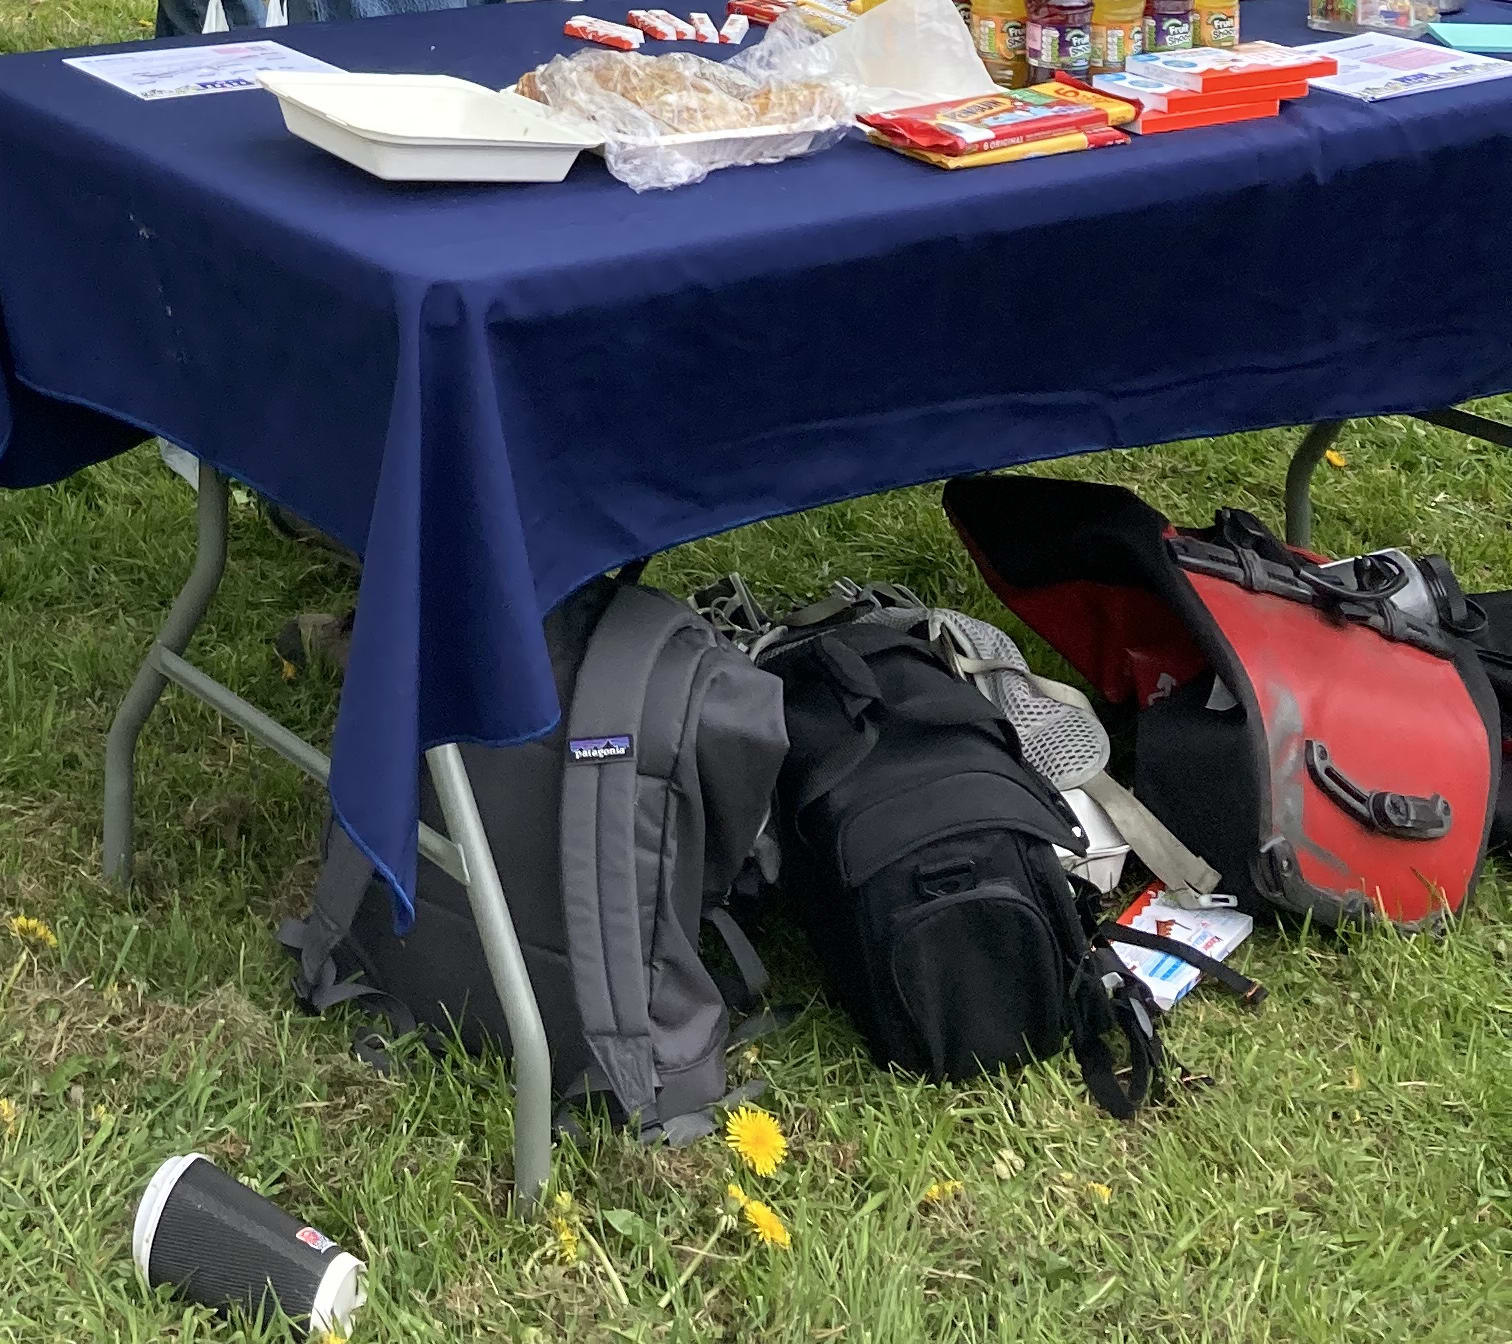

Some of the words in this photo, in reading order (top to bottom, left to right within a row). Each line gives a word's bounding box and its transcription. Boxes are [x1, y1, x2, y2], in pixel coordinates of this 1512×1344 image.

[1169, 23, 1189, 35] Fruit
[1214, 17, 1234, 30] Fruit
[990, 136, 1025, 150] ORIGINAL
[574, 745, 626, 760] patagonia
